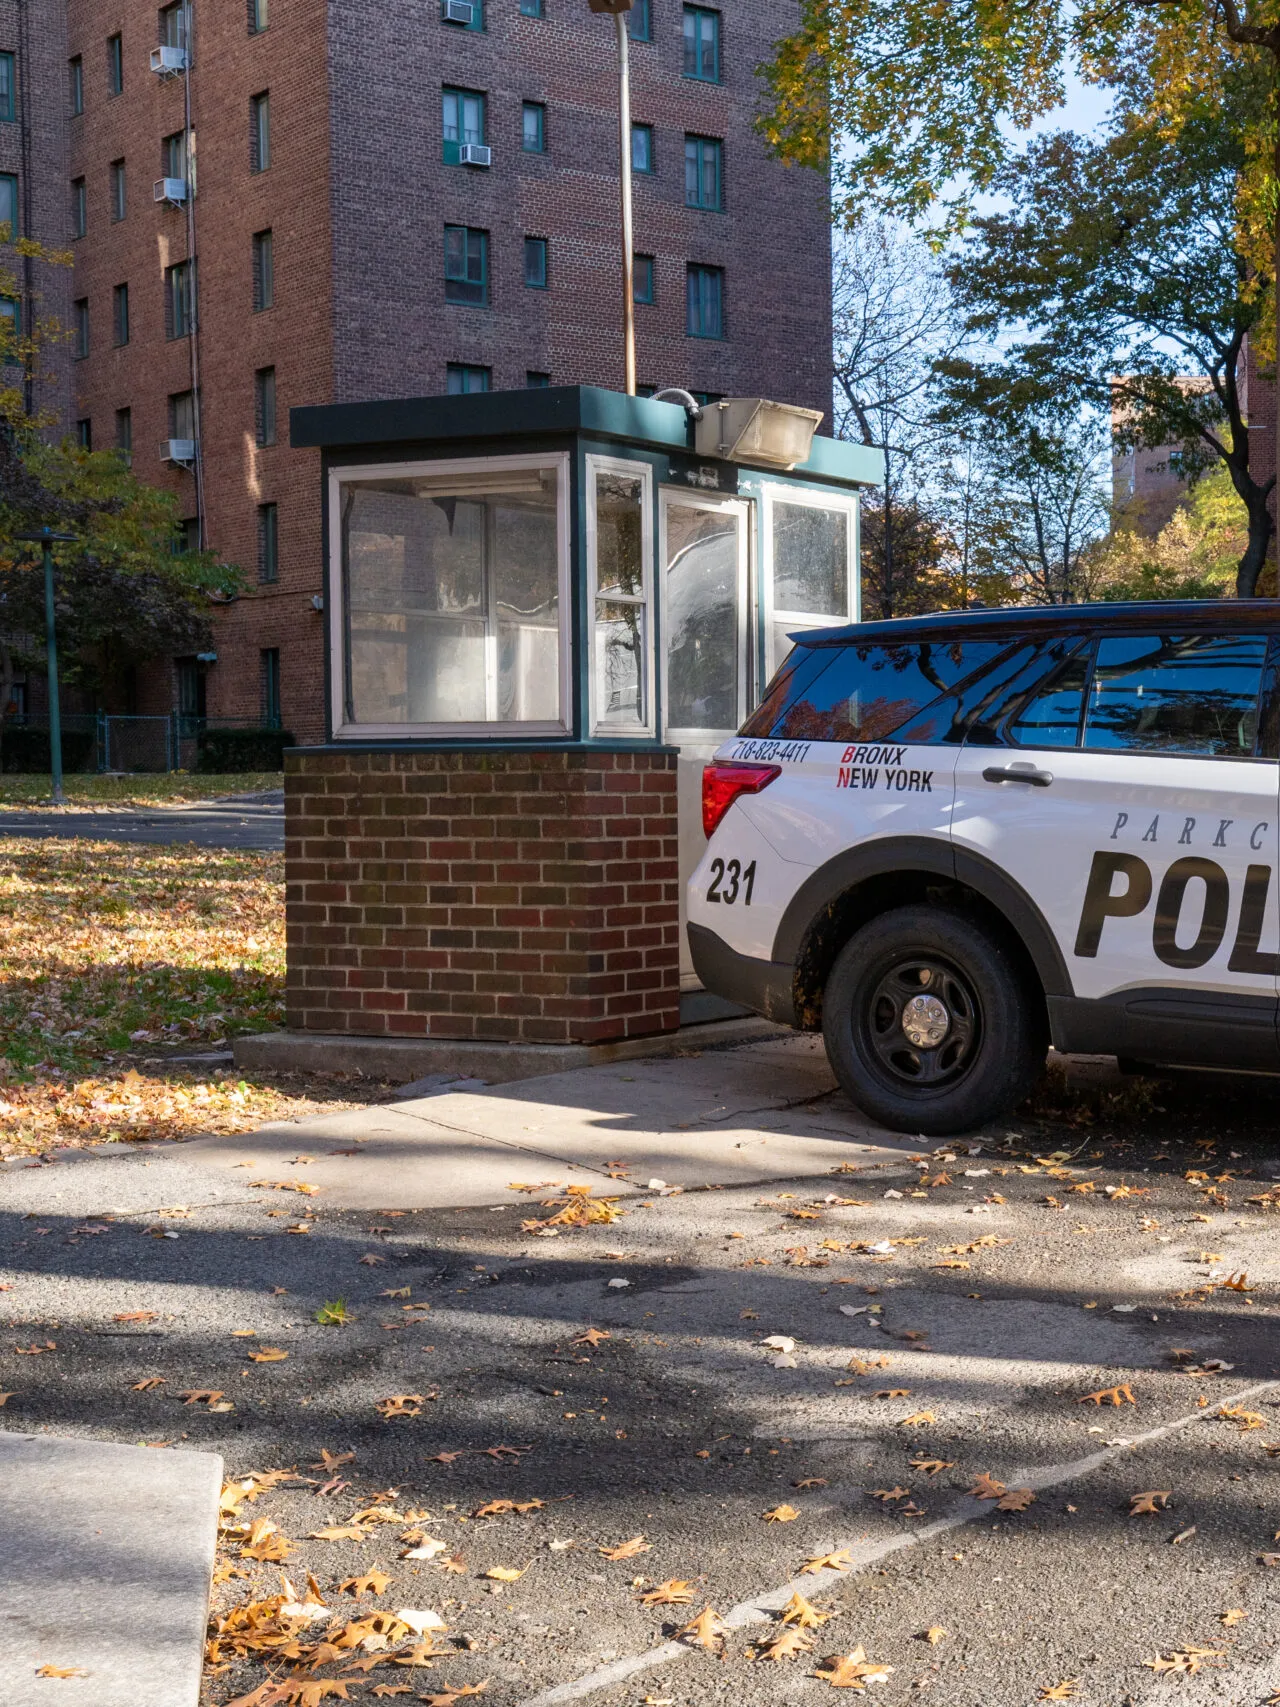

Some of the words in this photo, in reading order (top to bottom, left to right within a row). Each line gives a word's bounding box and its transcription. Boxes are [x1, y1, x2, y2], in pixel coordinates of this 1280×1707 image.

[733, 741, 811, 763] 718-823-4411
[841, 746, 908, 765] BRONX
[836, 767, 878, 788] NEW
[885, 770, 934, 792] YORK
[706, 857, 757, 906] 231
